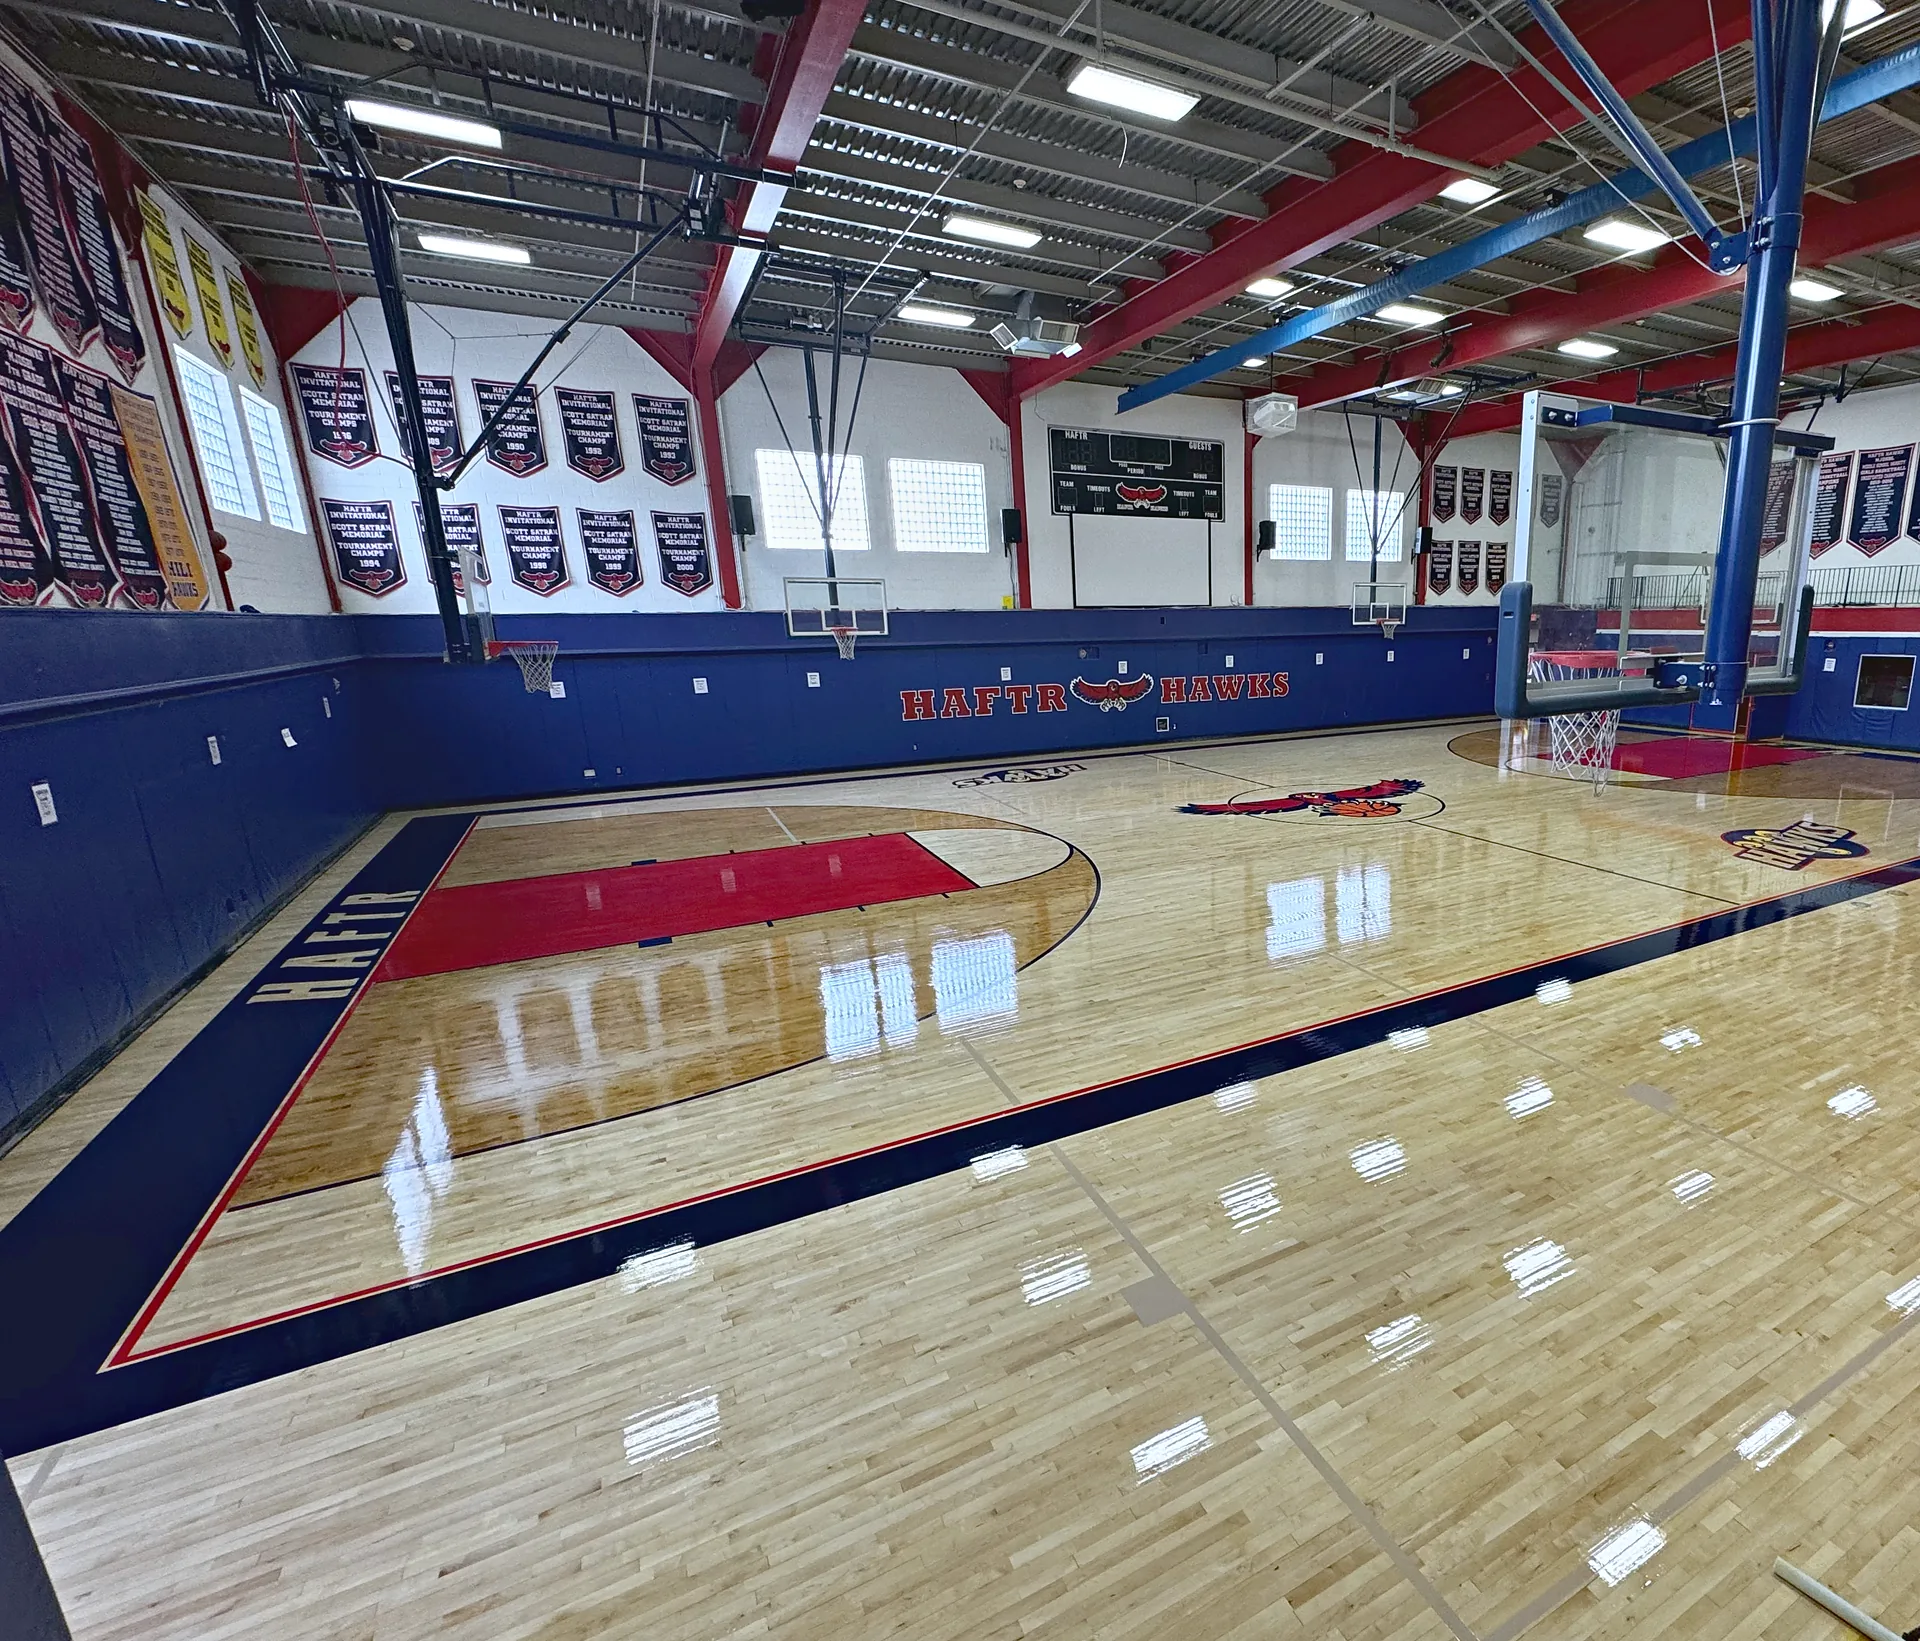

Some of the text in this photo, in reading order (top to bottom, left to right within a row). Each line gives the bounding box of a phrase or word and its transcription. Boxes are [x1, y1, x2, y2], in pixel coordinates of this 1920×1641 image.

[302, 390, 329, 398] SCOTT
[421, 400, 453, 408] SATRAN
[561, 399, 611, 409] INVITATIONAL
[422, 407, 446, 415] ORIAL
[563, 410, 584, 418] SCOTT
[639, 406, 684, 415] INVITATIONAL
[571, 419, 608, 427] MEMORIAL
[567, 429, 614, 438] TOURNAMENT
[1065, 430, 1088, 440] HAFTR
[643, 434, 687, 444] TOURNAMENT
[1189, 441, 1211, 451] GUESTS
[330, 511, 387, 519] INVITATIONAL
[900, 672, 1290, 722] HAFTR HAWKS
[245, 889, 422, 1005] HAFTR
